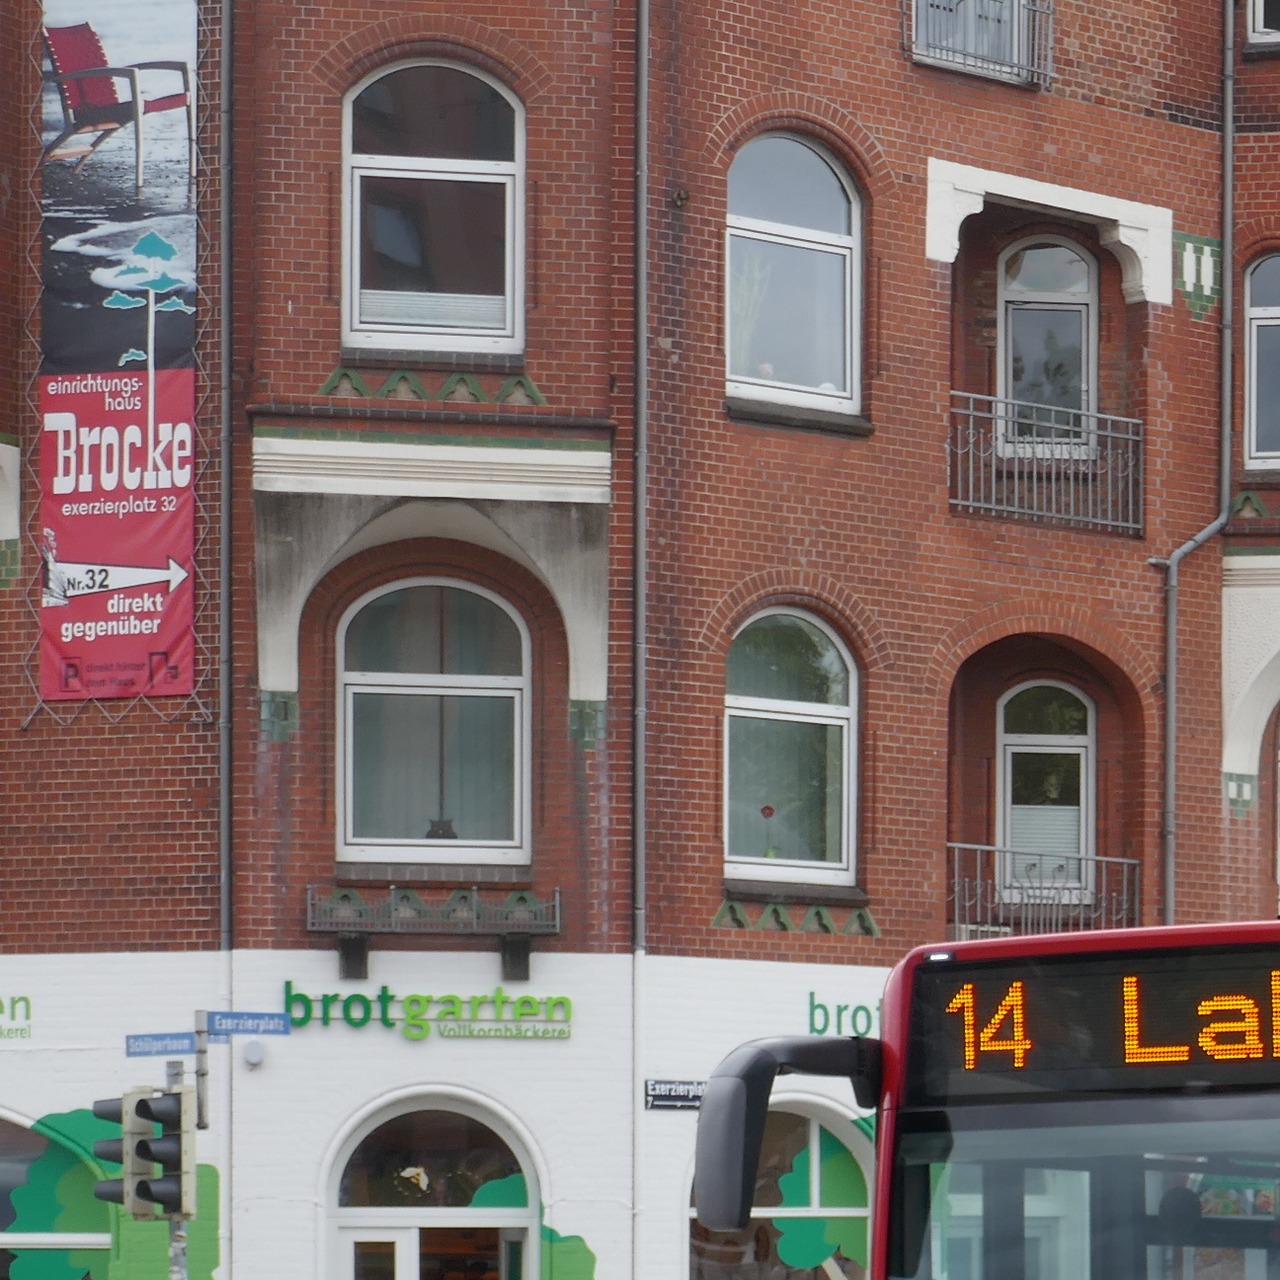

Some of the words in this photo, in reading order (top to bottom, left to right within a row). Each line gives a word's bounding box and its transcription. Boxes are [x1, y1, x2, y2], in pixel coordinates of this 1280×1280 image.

[47, 374, 143, 397] einrichtungs-
[105, 393, 142, 411] haus
[43, 411, 192, 494] Brocke
[62, 495, 157, 519] exerzierplatz
[161, 496, 177, 512] 32
[66, 568, 110, 591] Nr.32
[107, 593, 163, 613] direkt
[61, 616, 161, 642] gegenüber
[284, 981, 572, 1040] brotgarten
[214, 1015, 286, 1032] Exerzierplatz
[438, 1022, 571, 1039] Vollkornbäckerei
[946, 981, 1031, 1070] 14
